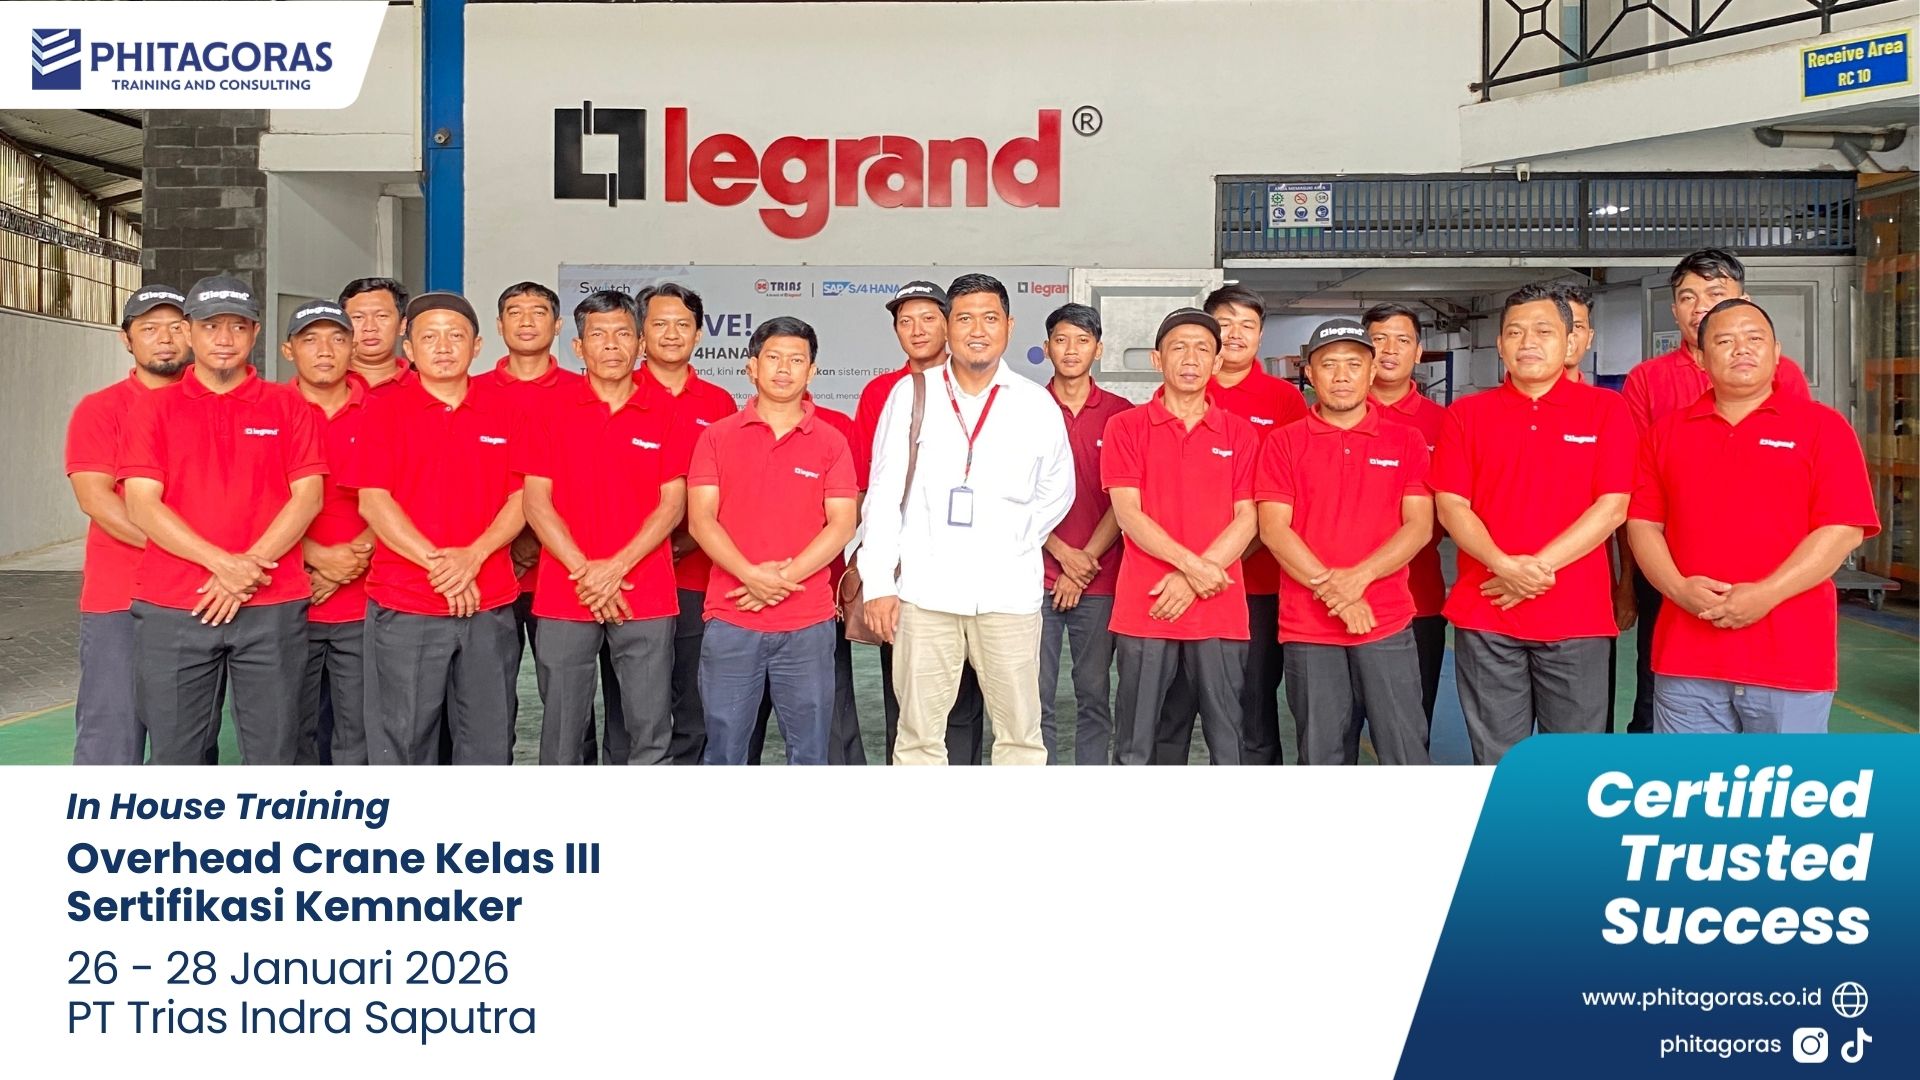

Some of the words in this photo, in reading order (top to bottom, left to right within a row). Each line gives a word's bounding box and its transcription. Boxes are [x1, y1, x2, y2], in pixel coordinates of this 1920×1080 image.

[1807, 46, 1864, 69] Receive
[1867, 40, 1904, 58] Area
[1838, 71, 1855, 86] RC
[1857, 68, 1872, 83] 10
[664, 107, 1062, 239] legrand
[770, 282, 801, 291] TRIAS
[869, 284, 900, 294] HANA
[1031, 281, 1069, 297] legran
[702, 313, 752, 337] VE!
[694, 347, 750, 360] 4HANA
[717, 367, 734, 376] kini
[838, 368, 871, 376] sistem
